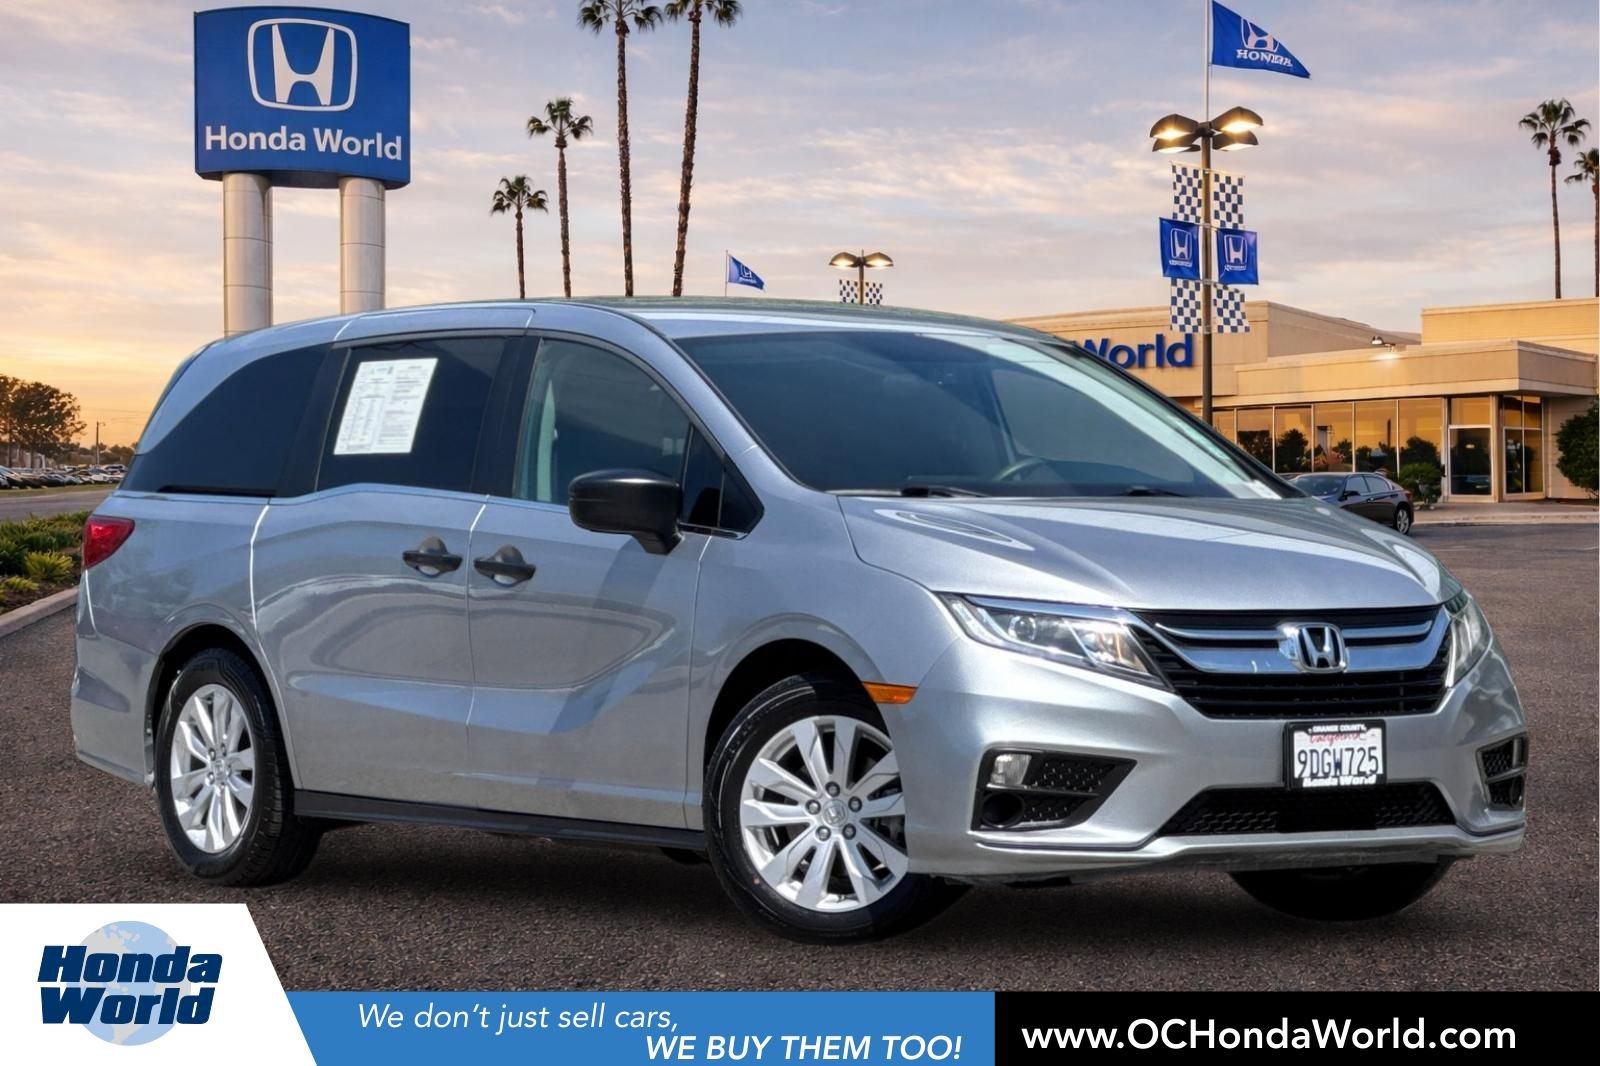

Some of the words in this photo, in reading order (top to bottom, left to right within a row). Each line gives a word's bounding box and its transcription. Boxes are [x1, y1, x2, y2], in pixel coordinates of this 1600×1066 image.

[205, 125, 306, 151] Honda
[313, 127, 402, 161] World
[1297, 746, 1379, 777] 9DGW725
[1339, 774, 1377, 786] World
